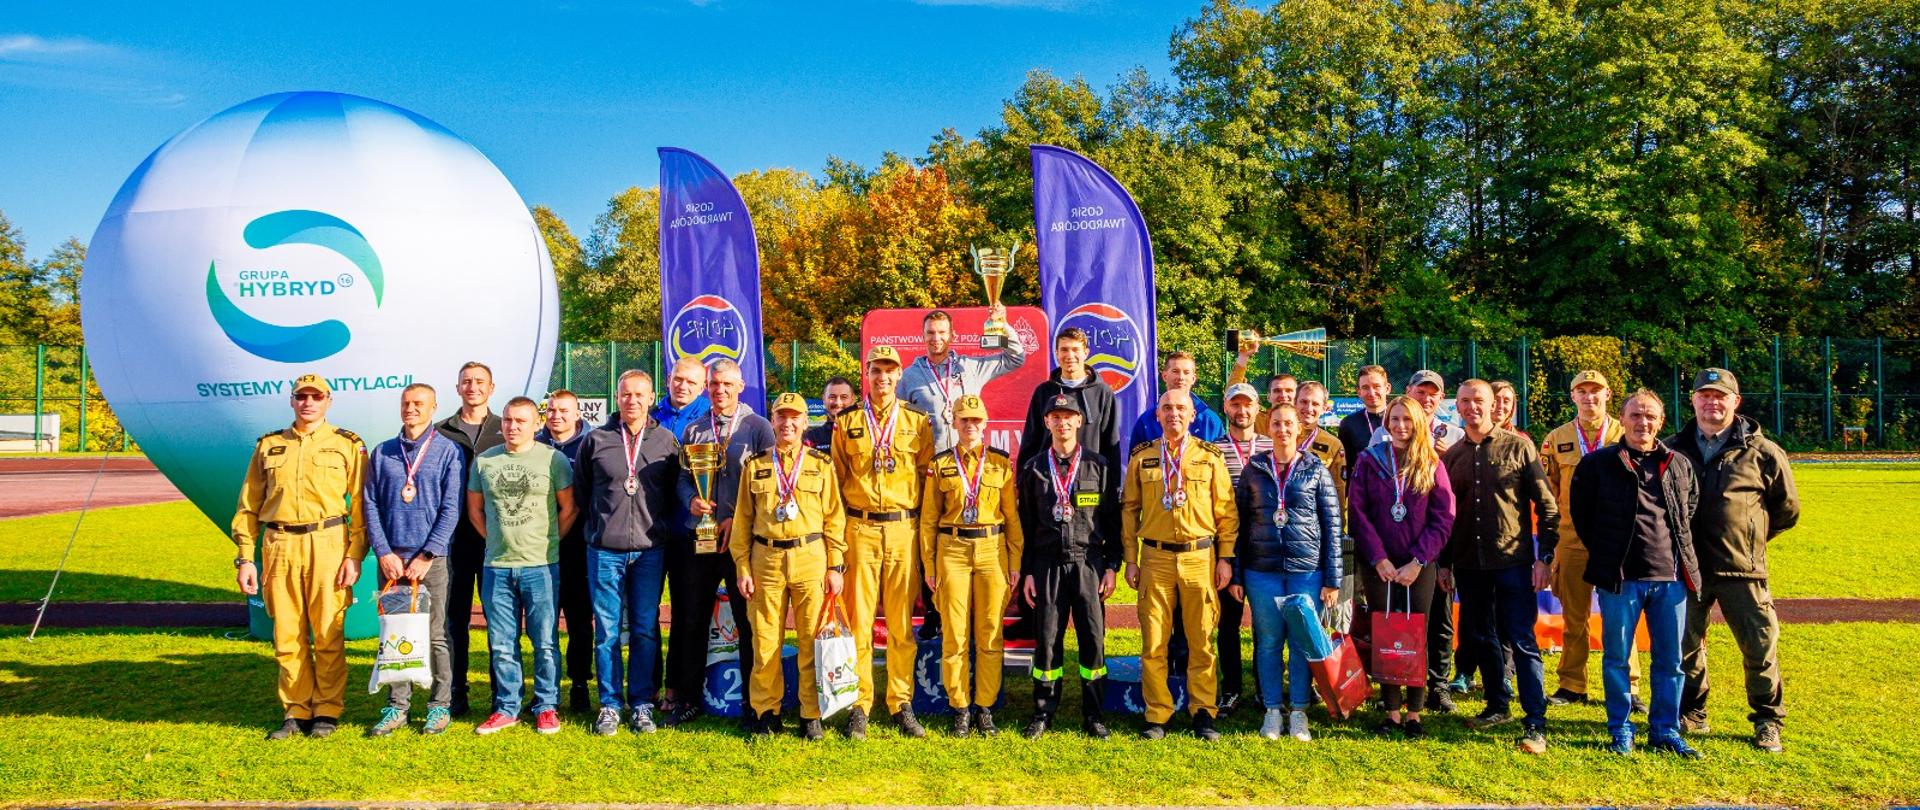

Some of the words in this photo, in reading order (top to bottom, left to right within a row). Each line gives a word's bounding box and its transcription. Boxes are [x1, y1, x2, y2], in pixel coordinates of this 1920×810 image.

[239, 270, 289, 280] GRUPA
[239, 280, 336, 297] HYBRYD
[870, 333, 926, 345] PAŃSTWOW
[197, 380, 283, 397] SYSTEMY
[290, 374, 413, 393] NTYLACJI
[577, 402, 602, 412] LNY
[723, 668, 743, 700] 2
